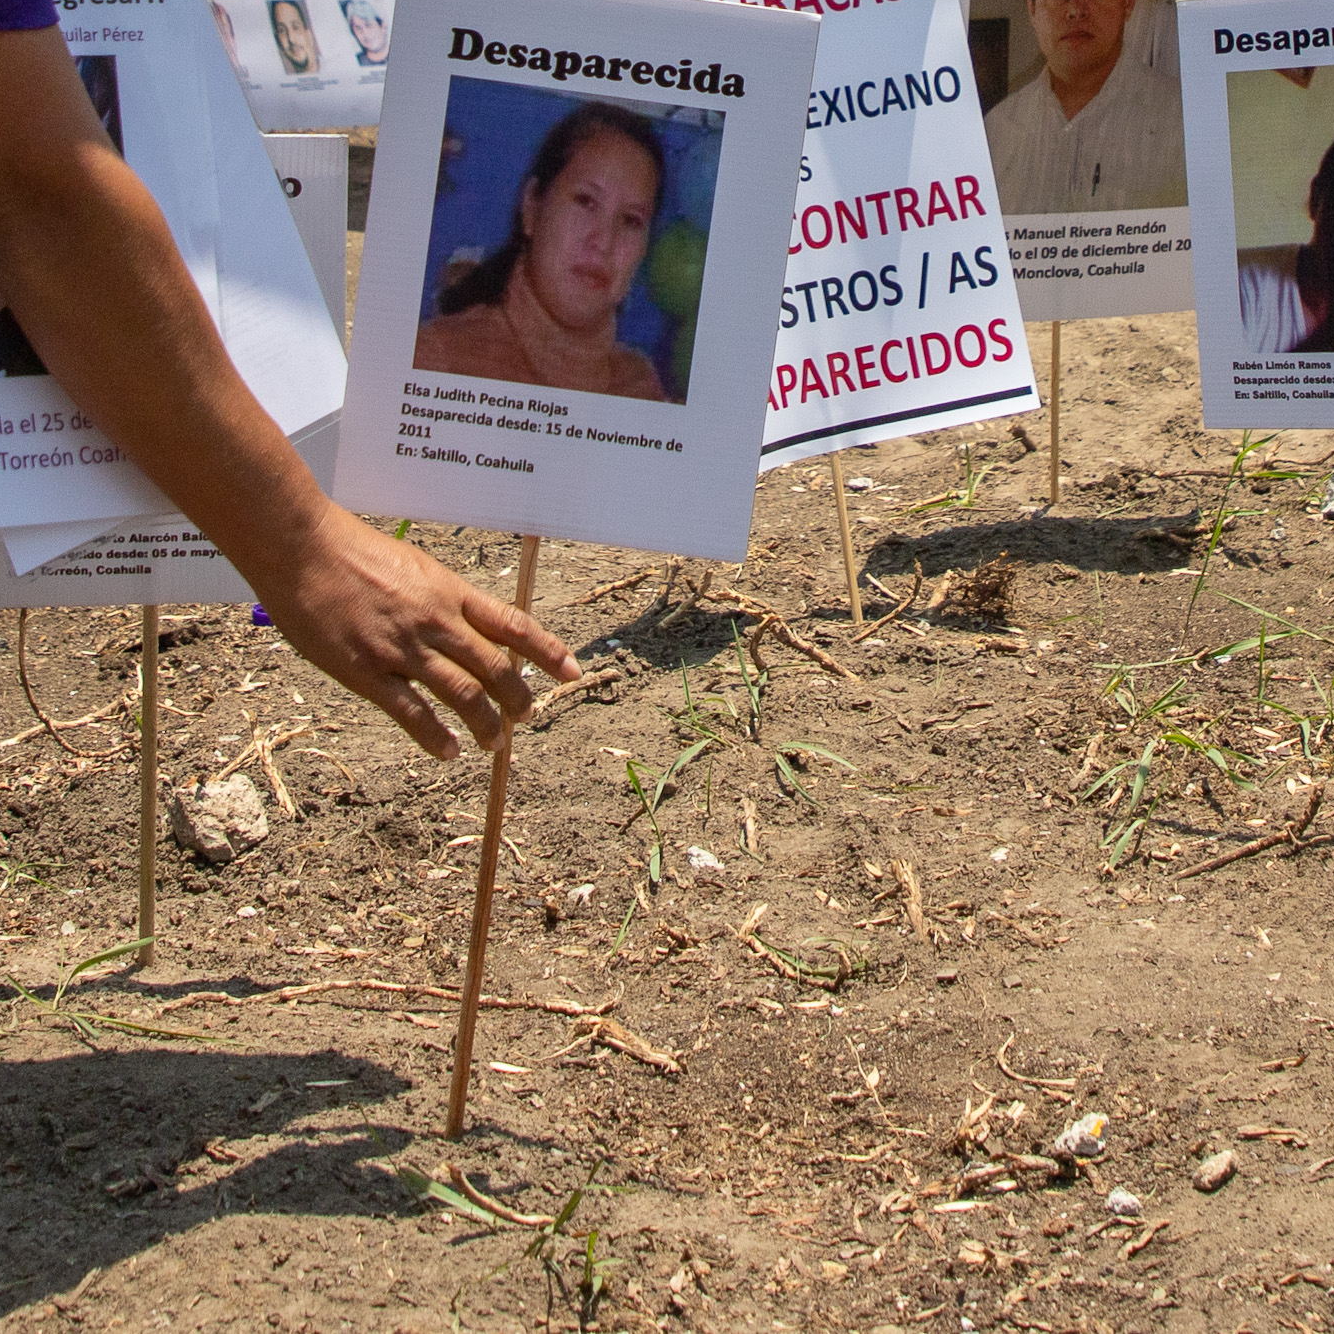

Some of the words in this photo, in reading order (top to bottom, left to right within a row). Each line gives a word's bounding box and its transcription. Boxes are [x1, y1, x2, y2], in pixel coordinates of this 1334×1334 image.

[62, 26, 98, 43] uilar
[102, 26, 145, 43] Pérez
[446, 26, 746, 99] Desaparecida
[805, 65, 961, 130] EXICANO
[787, 174, 987, 256] ONTRAR
[1013, 226, 1066, 241] Manuel
[1069, 224, 1113, 238] Rivera
[1116, 221, 1167, 236] Rendón
[1025, 247, 1038, 260] el
[1041, 246, 1058, 259] 09
[1061, 244, 1079, 258] de
[1082, 241, 1149, 258] diciembre
[1152, 239, 1172, 253] del
[1175, 238, 1192, 252] 20
[1013, 264, 1084, 280] Monclova,
[1087, 261, 1145, 277] Coahuila
[777, 264, 904, 331] STROS
[948, 245, 999, 294] AS
[1232, 360, 1263, 371] Rubén
[1265, 360, 1296, 370] Limón
[1298, 361, 1332, 370] Ramos
[1233, 375, 1300, 386] Desaparecido
[403, 382, 431, 398] Elsa
[433, 386, 476, 404] Judith
[479, 392, 524, 410] Pecina
[527, 398, 569, 417] Riojas
[1234, 390, 1250, 400] En:
[1252, 390, 1290, 401] Saltillo,
[1292, 390, 1334, 400] Coahuila
[20, 413, 37, 435] el
[41, 412, 65, 433] 25
[398, 422, 433, 439] 2011
[400, 402, 493, 429] Desaparecida
[496, 414, 542, 434] desde:
[545, 423, 562, 436] 15
[565, 424, 584, 440] de
[586, 429, 663, 451] Noviembre
[665, 437, 684, 453] de
[395, 442, 418, 458] En:
[420, 446, 471, 467] Saltillo,
[475, 452, 535, 474] Coahuila
[129, 531, 178, 544] Alarcón
[106, 547, 149, 559] desde:
[151, 547, 168, 559] 05
[171, 547, 187, 559] de
[96, 564, 152, 576] Coahuila
